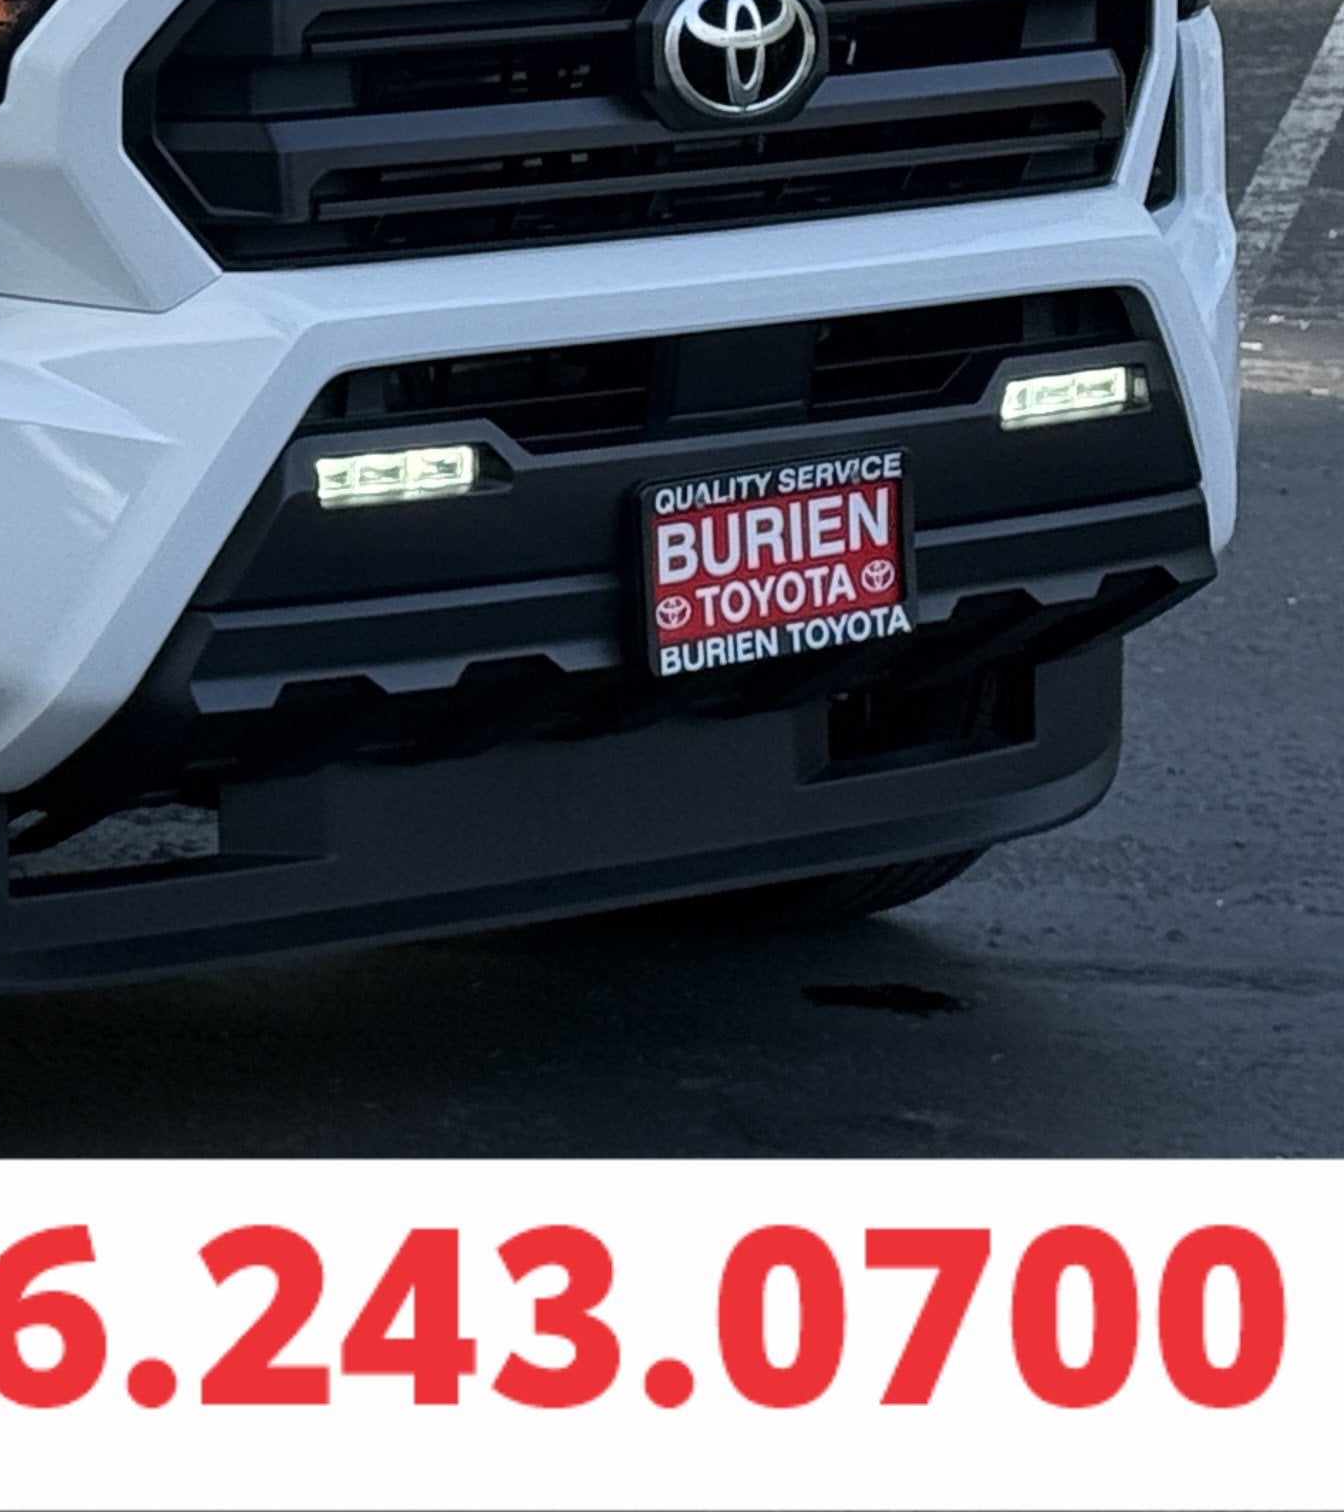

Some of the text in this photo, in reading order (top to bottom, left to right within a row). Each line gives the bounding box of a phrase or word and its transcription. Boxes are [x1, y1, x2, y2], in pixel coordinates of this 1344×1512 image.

[654, 451, 903, 515] QUALITY SERVICE
[656, 487, 890, 586] BURIEN
[695, 563, 857, 627] TOYOTA
[660, 605, 913, 678] BURIEN TOYOTA
